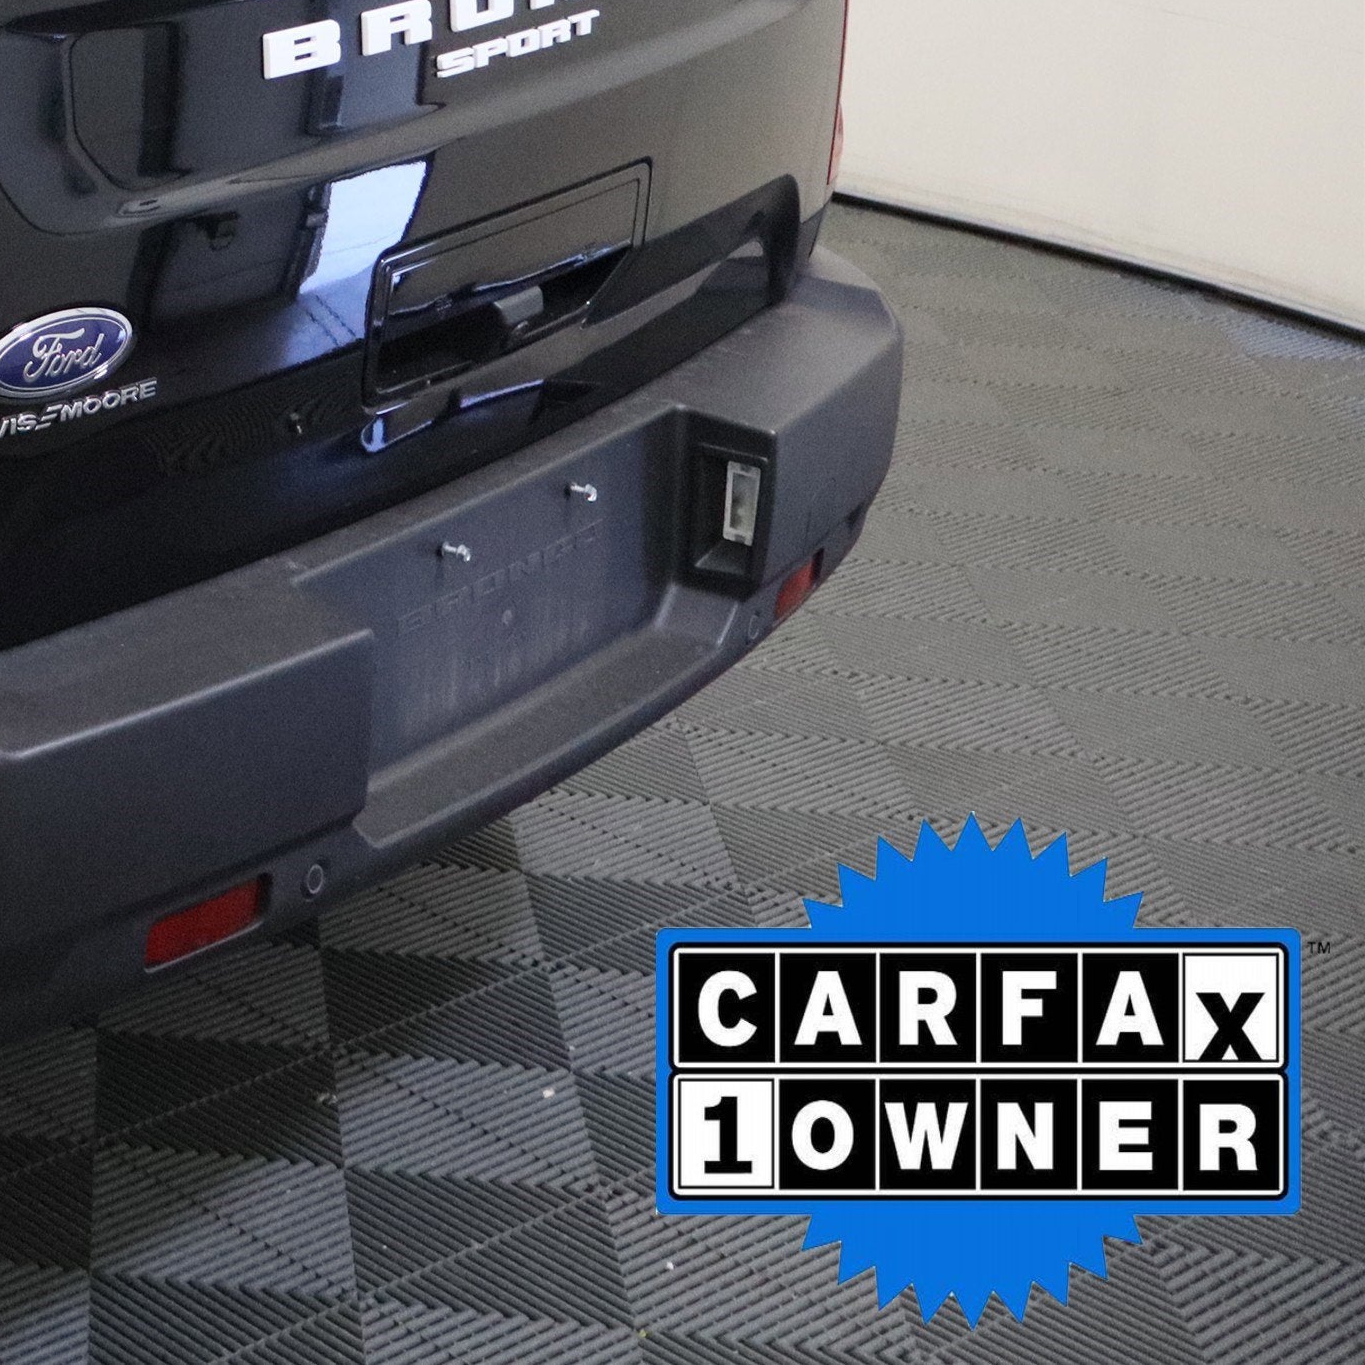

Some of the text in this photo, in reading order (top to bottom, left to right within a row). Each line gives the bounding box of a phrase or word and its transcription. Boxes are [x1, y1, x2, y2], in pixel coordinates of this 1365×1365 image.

[436, 9, 600, 78] SPORT
[23, 327, 105, 382] Ford
[60, 377, 158, 423] MOORE
